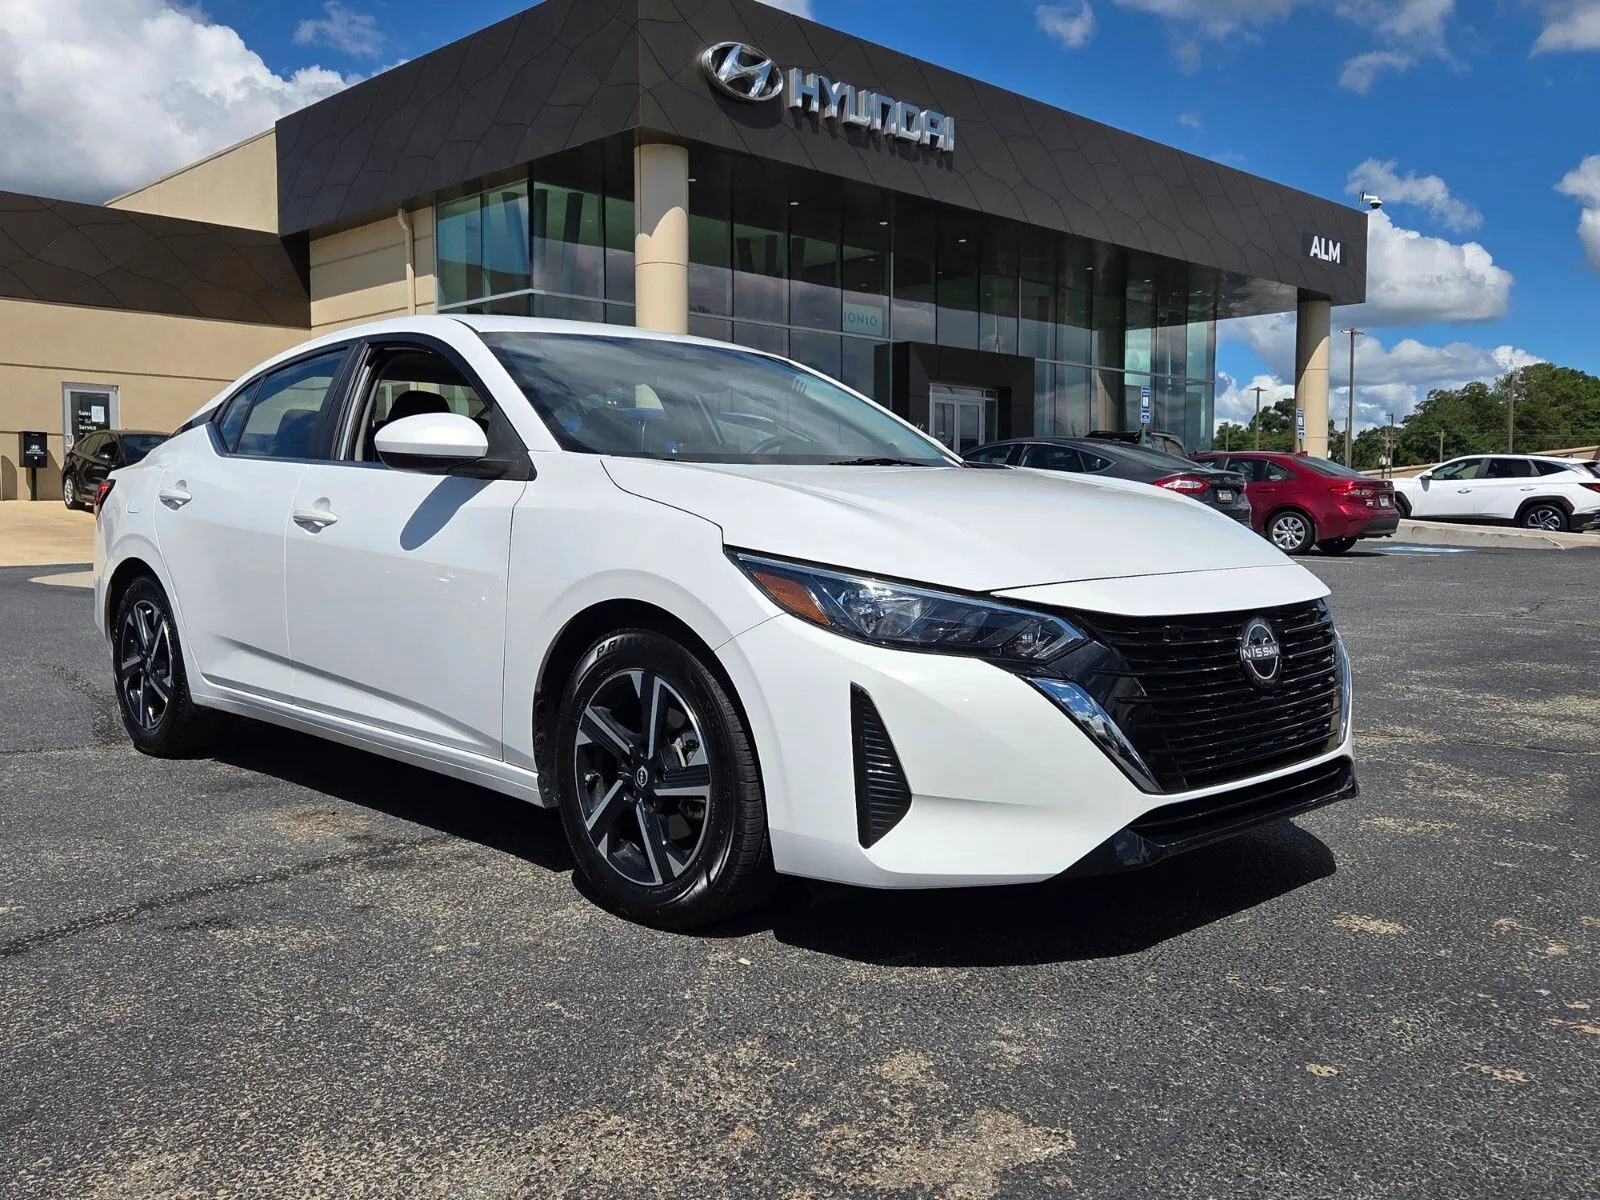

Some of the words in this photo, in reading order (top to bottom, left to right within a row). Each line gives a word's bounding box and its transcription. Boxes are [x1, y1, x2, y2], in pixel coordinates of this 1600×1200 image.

[789, 67, 955, 152] HYUNDAI
[1310, 235, 1341, 264] ALM
[1242, 645, 1280, 659] NISSAN
